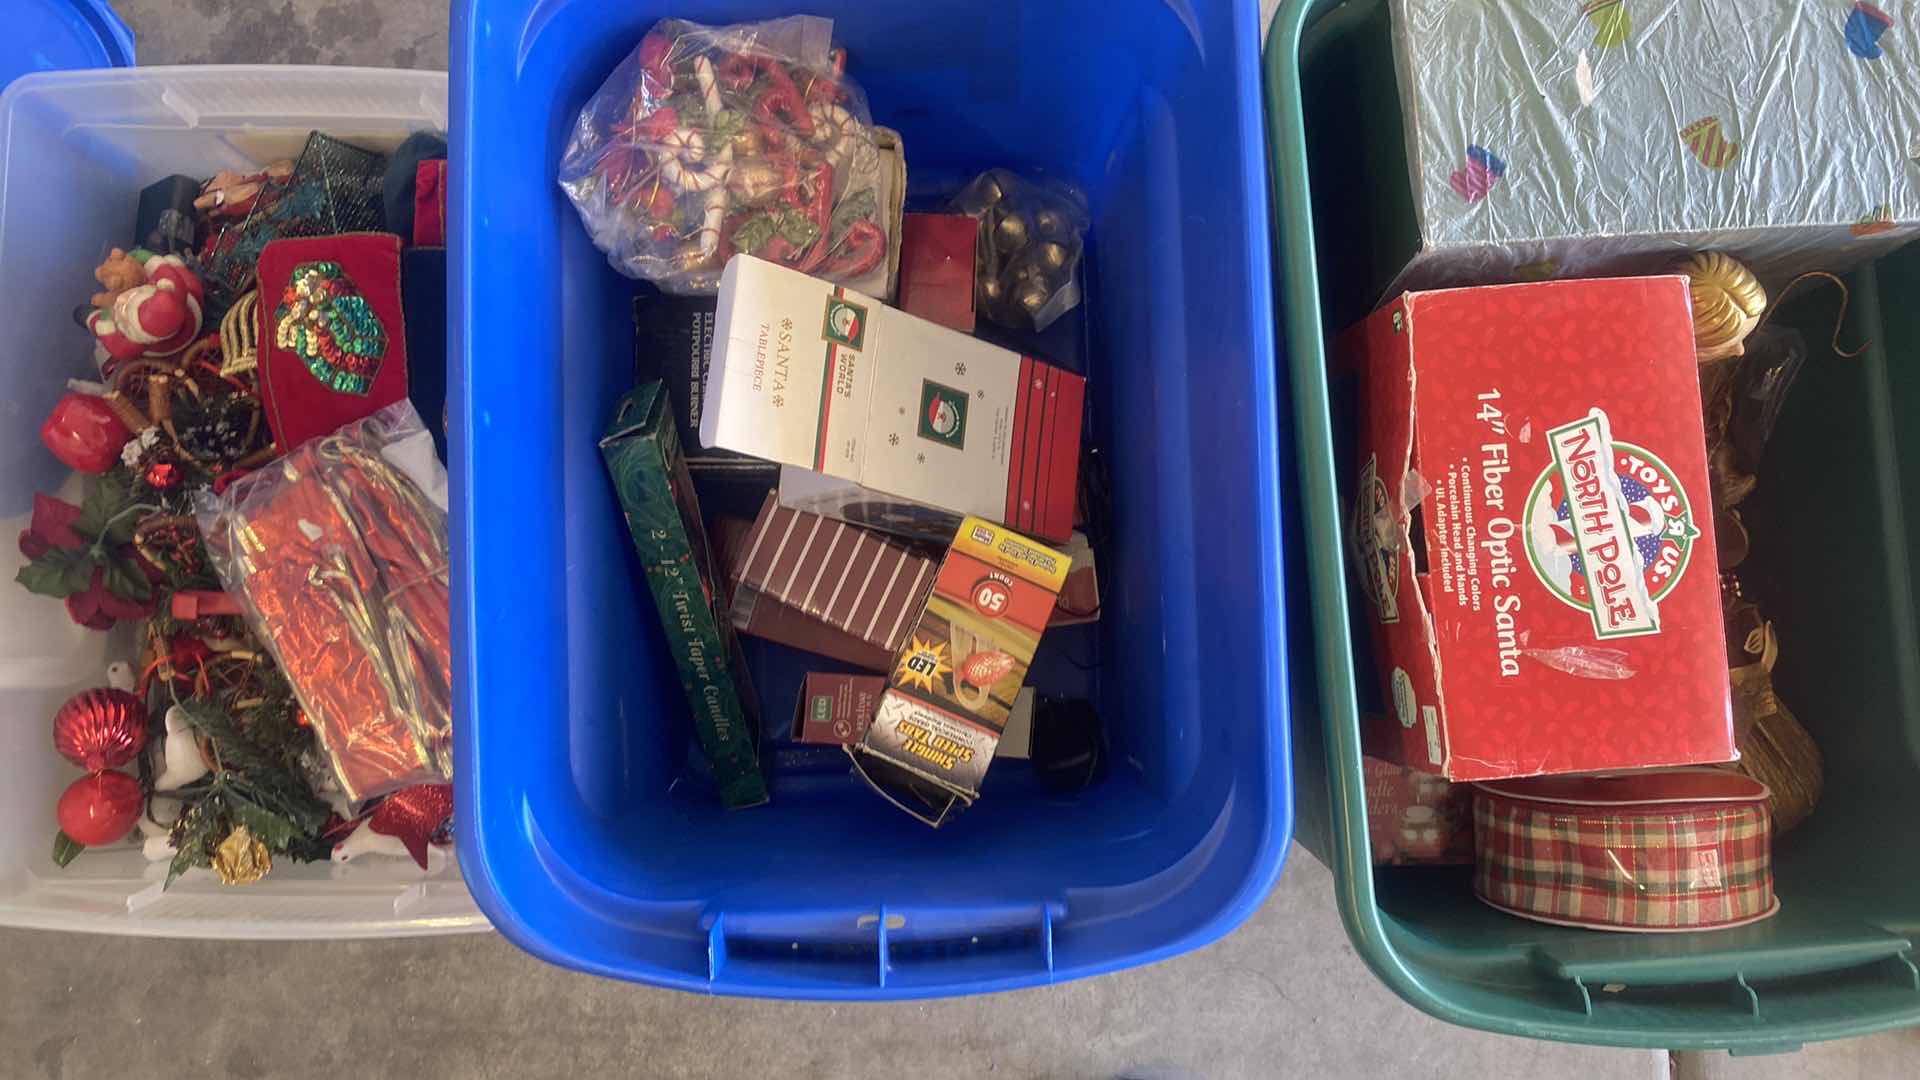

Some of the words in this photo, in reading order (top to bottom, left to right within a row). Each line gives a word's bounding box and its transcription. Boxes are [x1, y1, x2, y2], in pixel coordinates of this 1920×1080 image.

[752, 322, 769, 392] TABLEPIECE
[773, 331, 793, 394] SANTA
[836, 353, 847, 395] WORLD
[690, 381, 699, 429] BURNER
[1435, 487, 1445, 502] UL
[1447, 472, 1460, 520] Porcelain
[1460, 465, 1475, 523] Continuous
[1481, 443, 1511, 511] Fiber
[1435, 503, 1449, 545] Adapter
[1452, 522, 1464, 549] Head
[1561, 428, 1614, 536] NORTH
[1589, 536, 1637, 628] POLE
[1628, 455, 1679, 511] TOYS
[1657, 545, 1680, 578] US
[1440, 547, 1454, 593] Included
[1455, 552, 1466, 571] and
[1463, 526, 1480, 575] Changing
[1480, 517, 1516, 589] Optic
[978, 587, 1004, 612] 50
[989, 571, 1014, 587] COUNT
[1457, 574, 1469, 606] Hands
[1470, 578, 1482, 611] Colors
[651, 530, 667, 540] 2
[672, 590, 697, 633] Twist
[687, 637, 711, 682] Taper
[703, 685, 731, 742] Candles
[1494, 594, 1521, 677] Santa
[907, 655, 938, 677] LED
[816, 698, 827, 720] LED
[932, 736, 976, 764] SPEED
